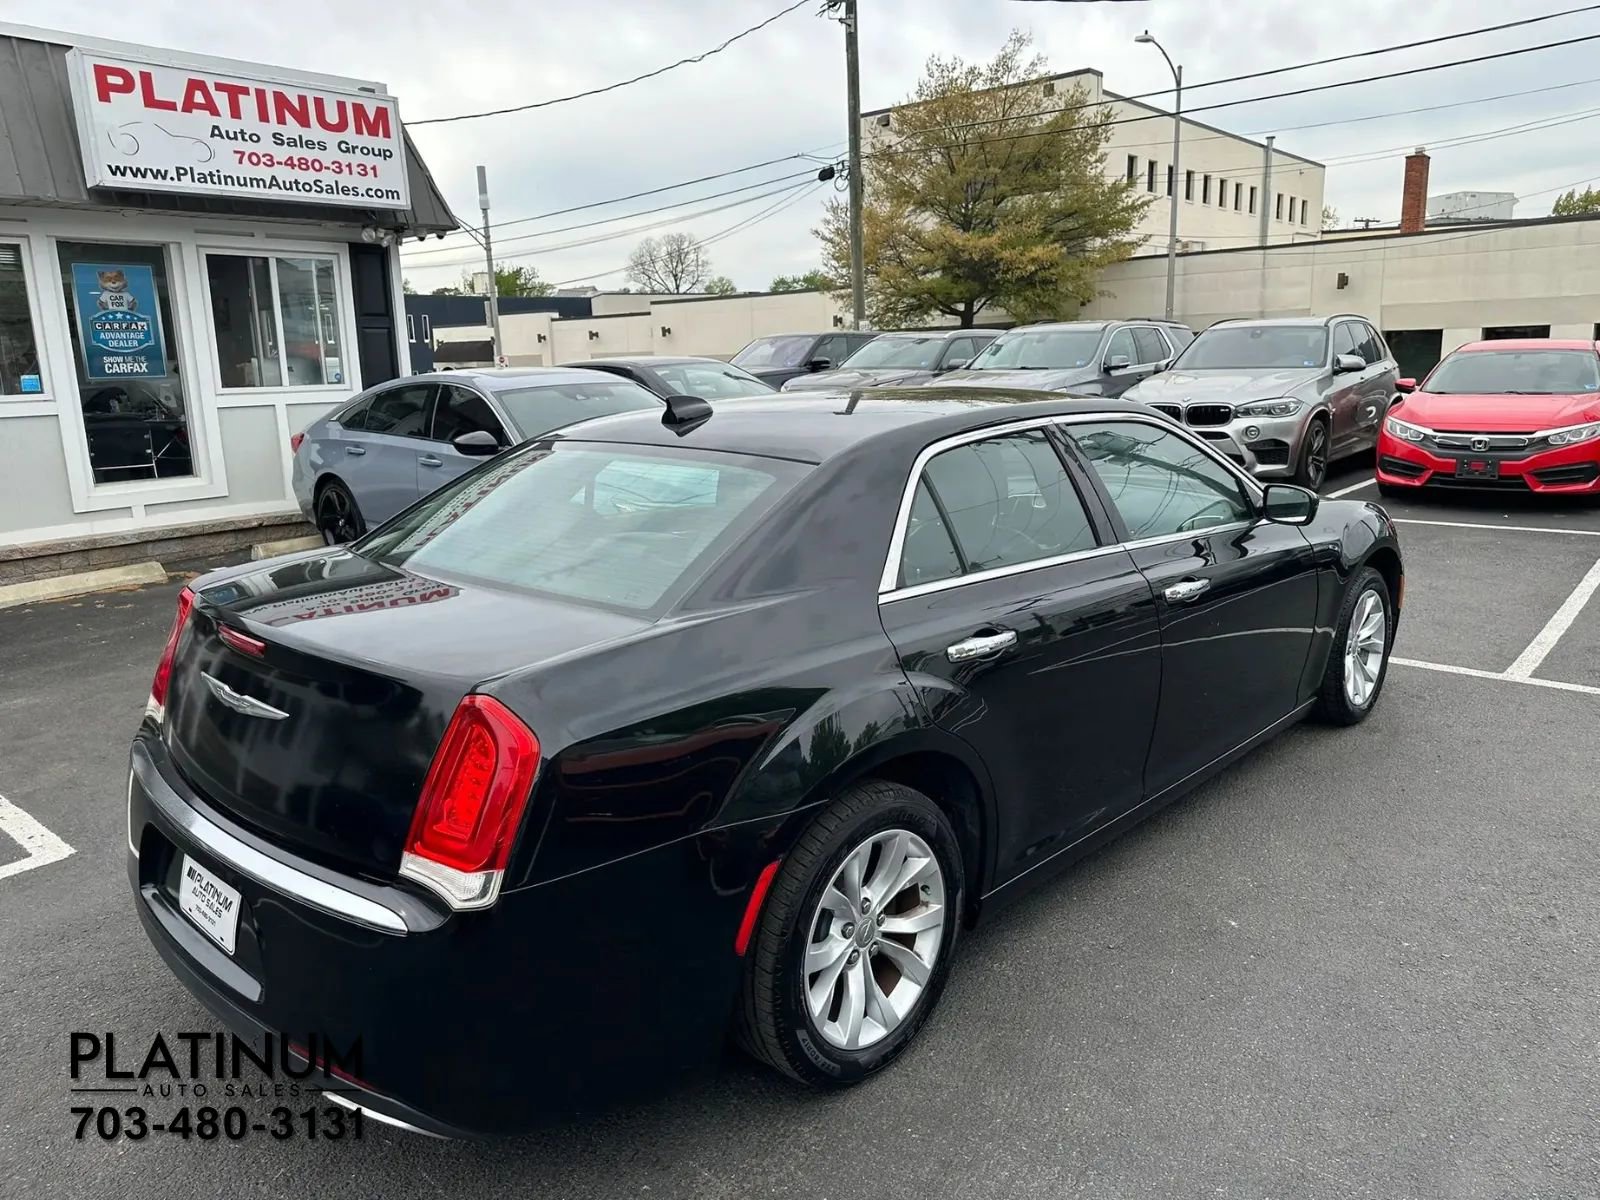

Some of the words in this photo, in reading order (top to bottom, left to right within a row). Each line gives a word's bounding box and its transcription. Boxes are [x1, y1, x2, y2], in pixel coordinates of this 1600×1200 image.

[93, 63, 391, 139] PLATINUM
[209, 124, 261, 144] Auto
[272, 132, 328, 152] Sales
[337, 140, 393, 160] Group
[233, 150, 379, 178] 703-480-3131
[106, 162, 400, 200] www.PlatinumAutoSales.com
[95, 322, 148, 331] CARFAX
[100, 332, 145, 340] ADVANTAGE
[104, 363, 149, 373] CARFAX
[192, 887, 206, 903] AUTO
[205, 899, 222, 918] SALES
[195, 873, 233, 912] PLATINUM
